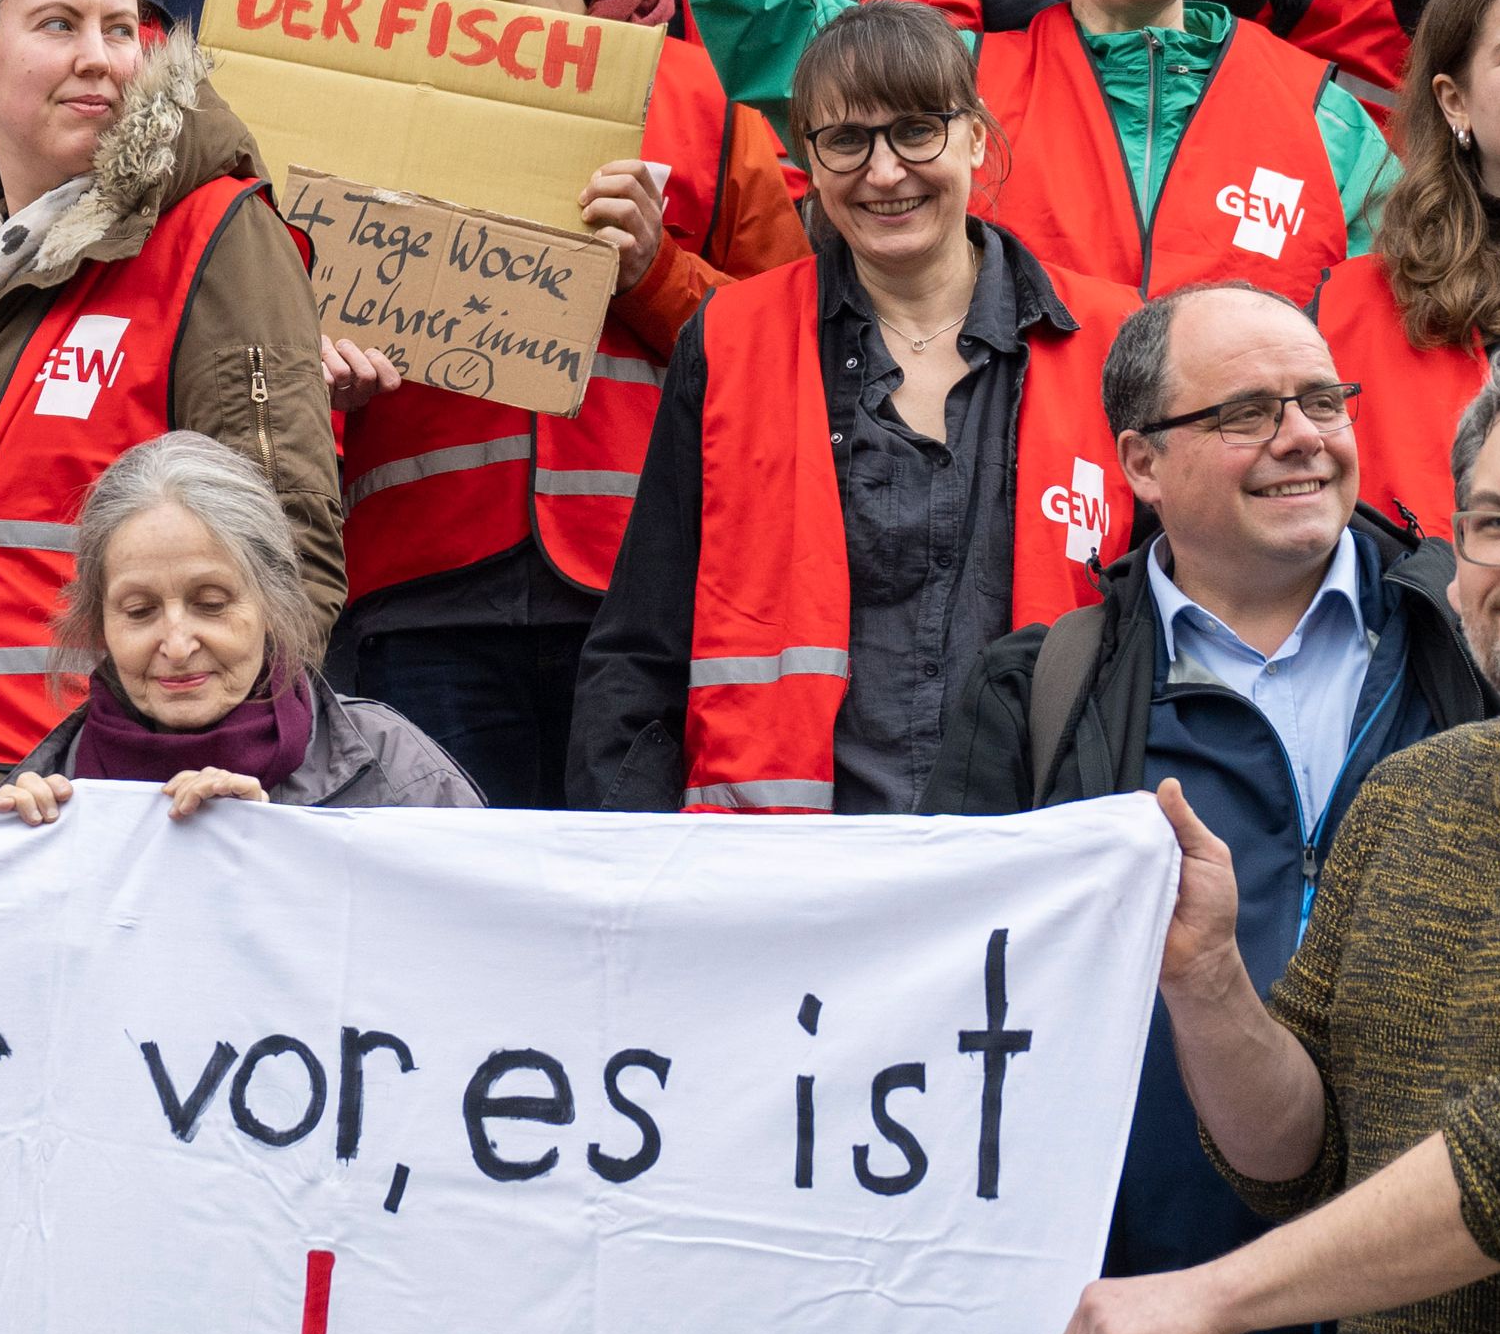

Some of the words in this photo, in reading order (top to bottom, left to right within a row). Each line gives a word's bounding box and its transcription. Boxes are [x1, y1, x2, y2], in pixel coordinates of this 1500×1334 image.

[286, 183, 336, 236] 4
[343, 191, 433, 285] Tage
[448, 218, 574, 301] Woche
[1215, 184, 1305, 236] GEW
[1041, 485, 1110, 536] GEW
[137, 1024, 416, 1216] vor,
[462, 1042, 674, 1185] es
[791, 927, 1034, 1202] ist
